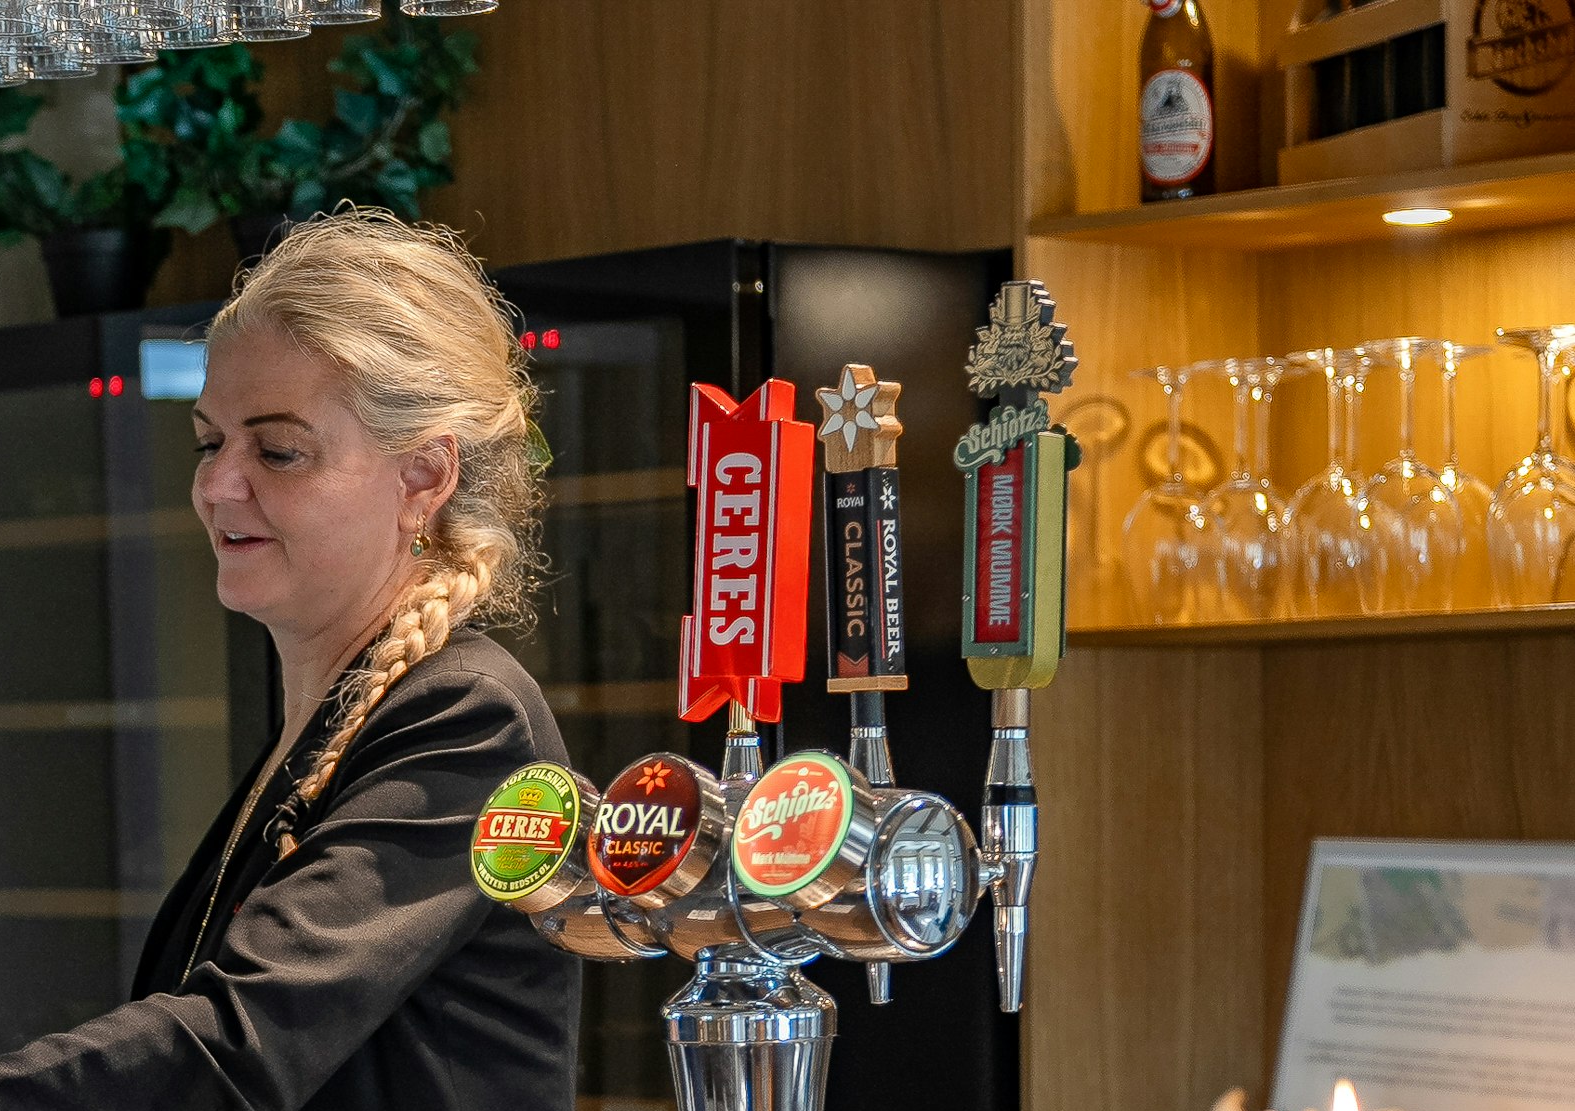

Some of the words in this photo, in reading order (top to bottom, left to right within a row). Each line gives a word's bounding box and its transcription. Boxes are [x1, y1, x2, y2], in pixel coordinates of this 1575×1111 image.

[836, 496, 865, 509] ROYAL
[709, 452, 763, 646] CERES
[882, 519, 899, 593] ROYAL
[844, 521, 866, 638] CLASSIC
[989, 539, 1014, 626] MUMME
[886, 598, 901, 654] BEER
[502, 771, 526, 791] TOP
[526, 769, 571, 798] PILSNER
[489, 815, 553, 839] CERES
[594, 803, 686, 837] ROYAL
[606, 840, 664, 856] CLASSIC
